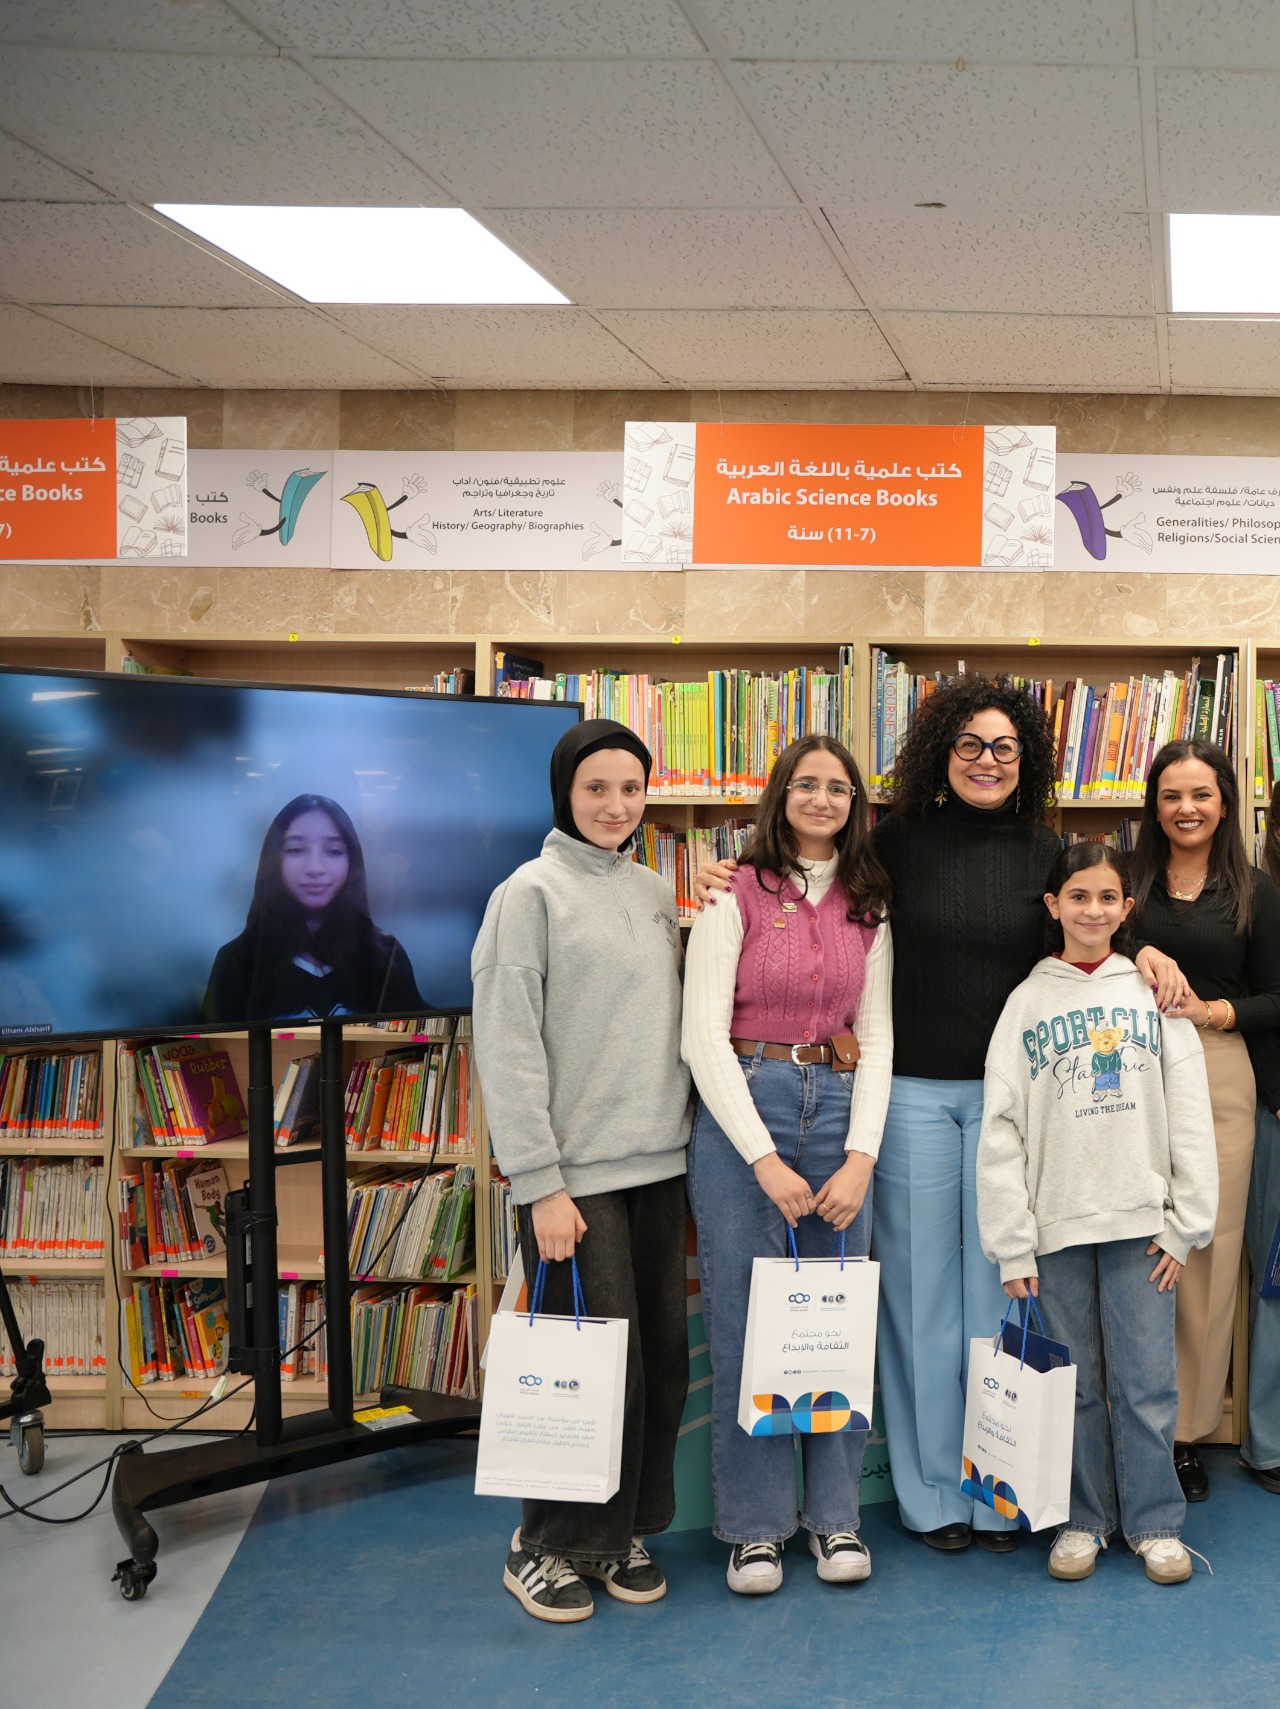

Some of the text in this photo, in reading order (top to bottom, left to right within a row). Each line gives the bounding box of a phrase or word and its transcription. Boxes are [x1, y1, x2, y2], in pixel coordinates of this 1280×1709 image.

[0, 456, 106, 476] كتب علمية
[716, 459, 962, 481] كتب علمية باللغة العربية
[542, 478, 565, 486] علوم
[22, 484, 83, 501] Books
[462, 488, 554, 498] تاريخ وجغرافيا وتراجم
[1152, 485, 1182, 495] ونفس
[1183, 486, 1203, 494] علم
[1205, 485, 1238, 494] فلسفة
[196, 491, 228, 503] كتب
[727, 488, 937, 506] Arabic Science Books
[1174, 497, 1275, 509] ديانات/ علوم اجتماعية
[190, 511, 228, 524] Books
[473, 508, 543, 517] Arts/ Literature
[432, 521, 584, 532] History/ Geography/ Biographies
[1156, 516, 1229, 528] Generalities/
[788, 525, 823, 540] سنة
[1157, 532, 1248, 545] Religions/Social
[884, 679, 897, 738] JOURNEY
[1, 1025, 51, 1036] Elham Alsharif
[1022, 1006, 1162, 1081] SPORT CLU
[189, 1058, 227, 1075] Rubber
[1075, 1102, 1137, 1118] LIVING THE DREAM
[194, 1174, 220, 1190] Human
[201, 1189, 221, 1201] Body
[791, 1329, 841, 1340] نحو مجتمع
[781, 1341, 849, 1354] الثقافة والإبداع
